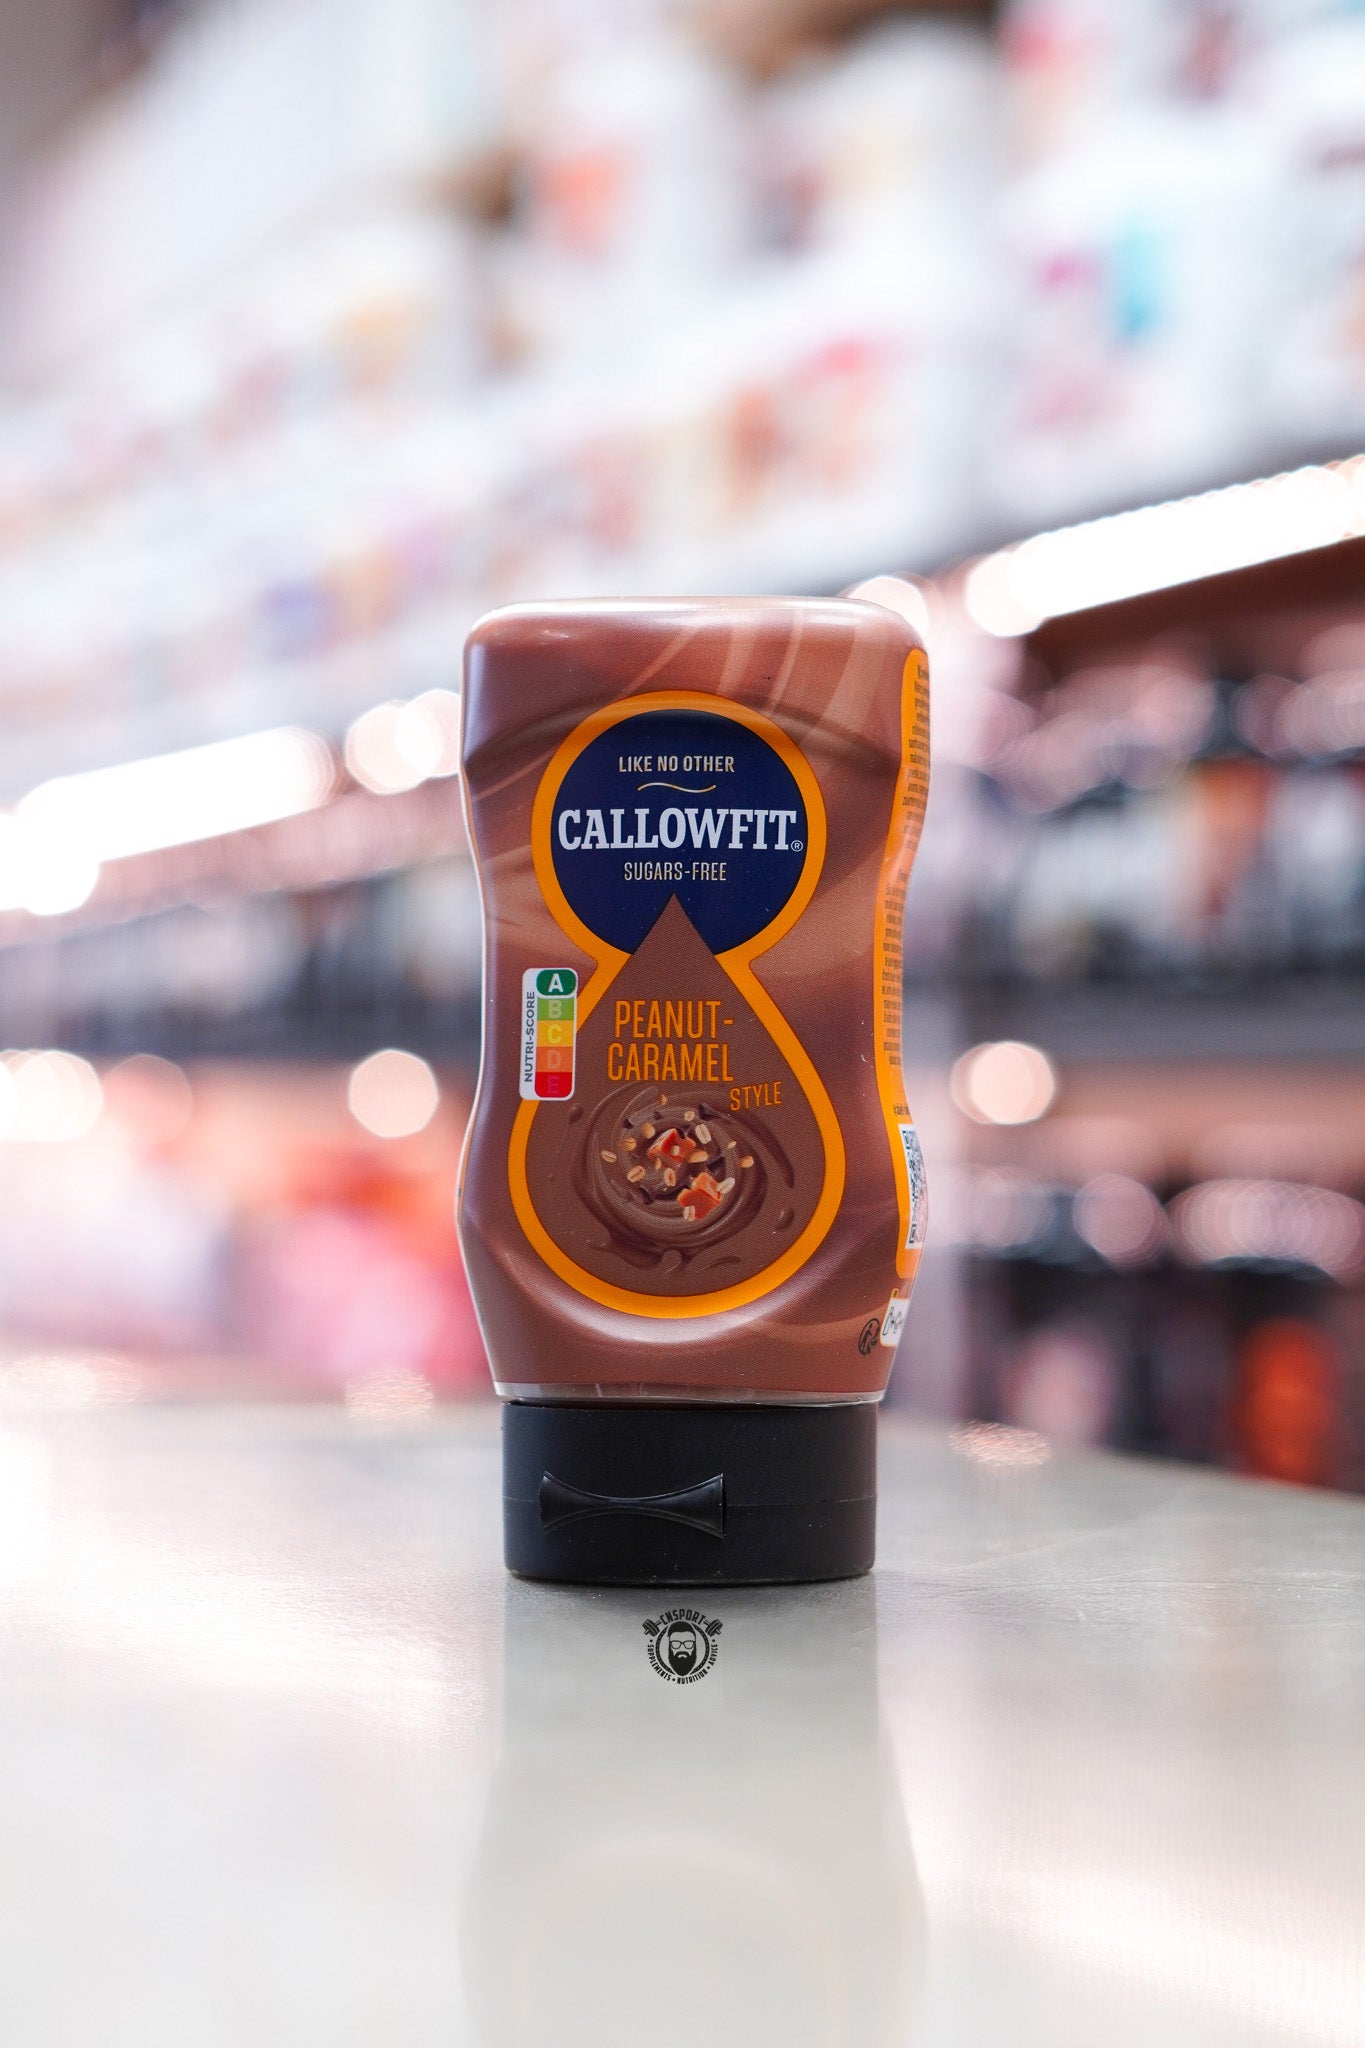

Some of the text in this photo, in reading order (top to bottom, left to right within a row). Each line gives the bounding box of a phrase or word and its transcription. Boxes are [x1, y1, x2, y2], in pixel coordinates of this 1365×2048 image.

[618, 755, 735, 773] LIKE NO OTHER
[623, 861, 728, 881] SUGARS-FREE
[547, 972, 564, 993] A
[547, 999, 563, 1019] B
[614, 1000, 734, 1039] PEANUT-
[523, 991, 536, 1083] NUTRI-SCORE
[546, 1023, 562, 1044] C
[546, 1049, 562, 1070] D
[607, 1042, 734, 1082] CARAMEL
[728, 1081, 783, 1112] STYLE
